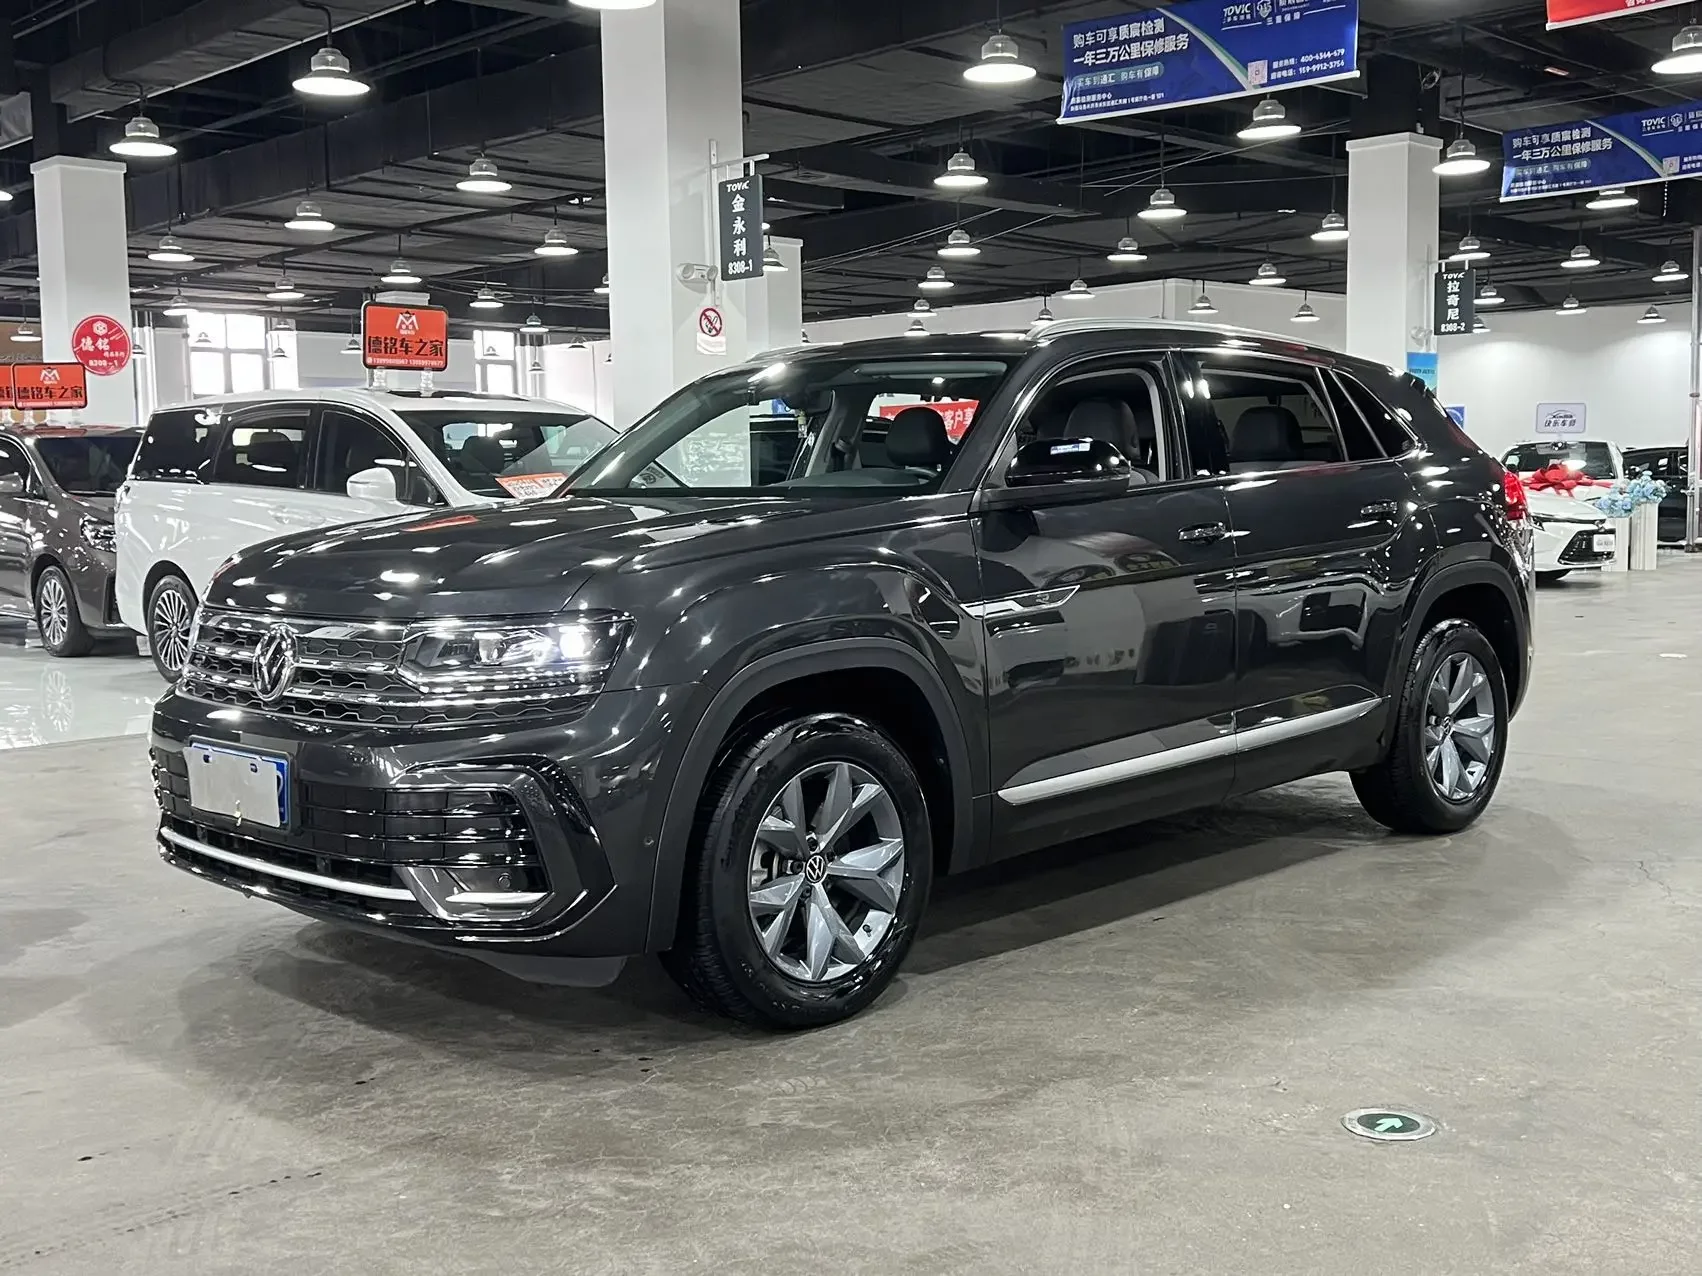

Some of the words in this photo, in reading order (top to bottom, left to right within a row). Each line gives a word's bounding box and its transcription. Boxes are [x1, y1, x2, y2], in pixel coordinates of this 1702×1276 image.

[1223, 3, 1251, 17] TOVIC
[1073, 33, 1189, 66] 一年三万公里保修服务
[1513, 138, 1613, 161] 一年三万公里保修服务
[731, 193, 747, 257] 金永利
[728, 259, 753, 275] 8308-1
[368, 336, 444, 357] 德铭车之家
[18, 386, 83, 399] 德铭车之家
